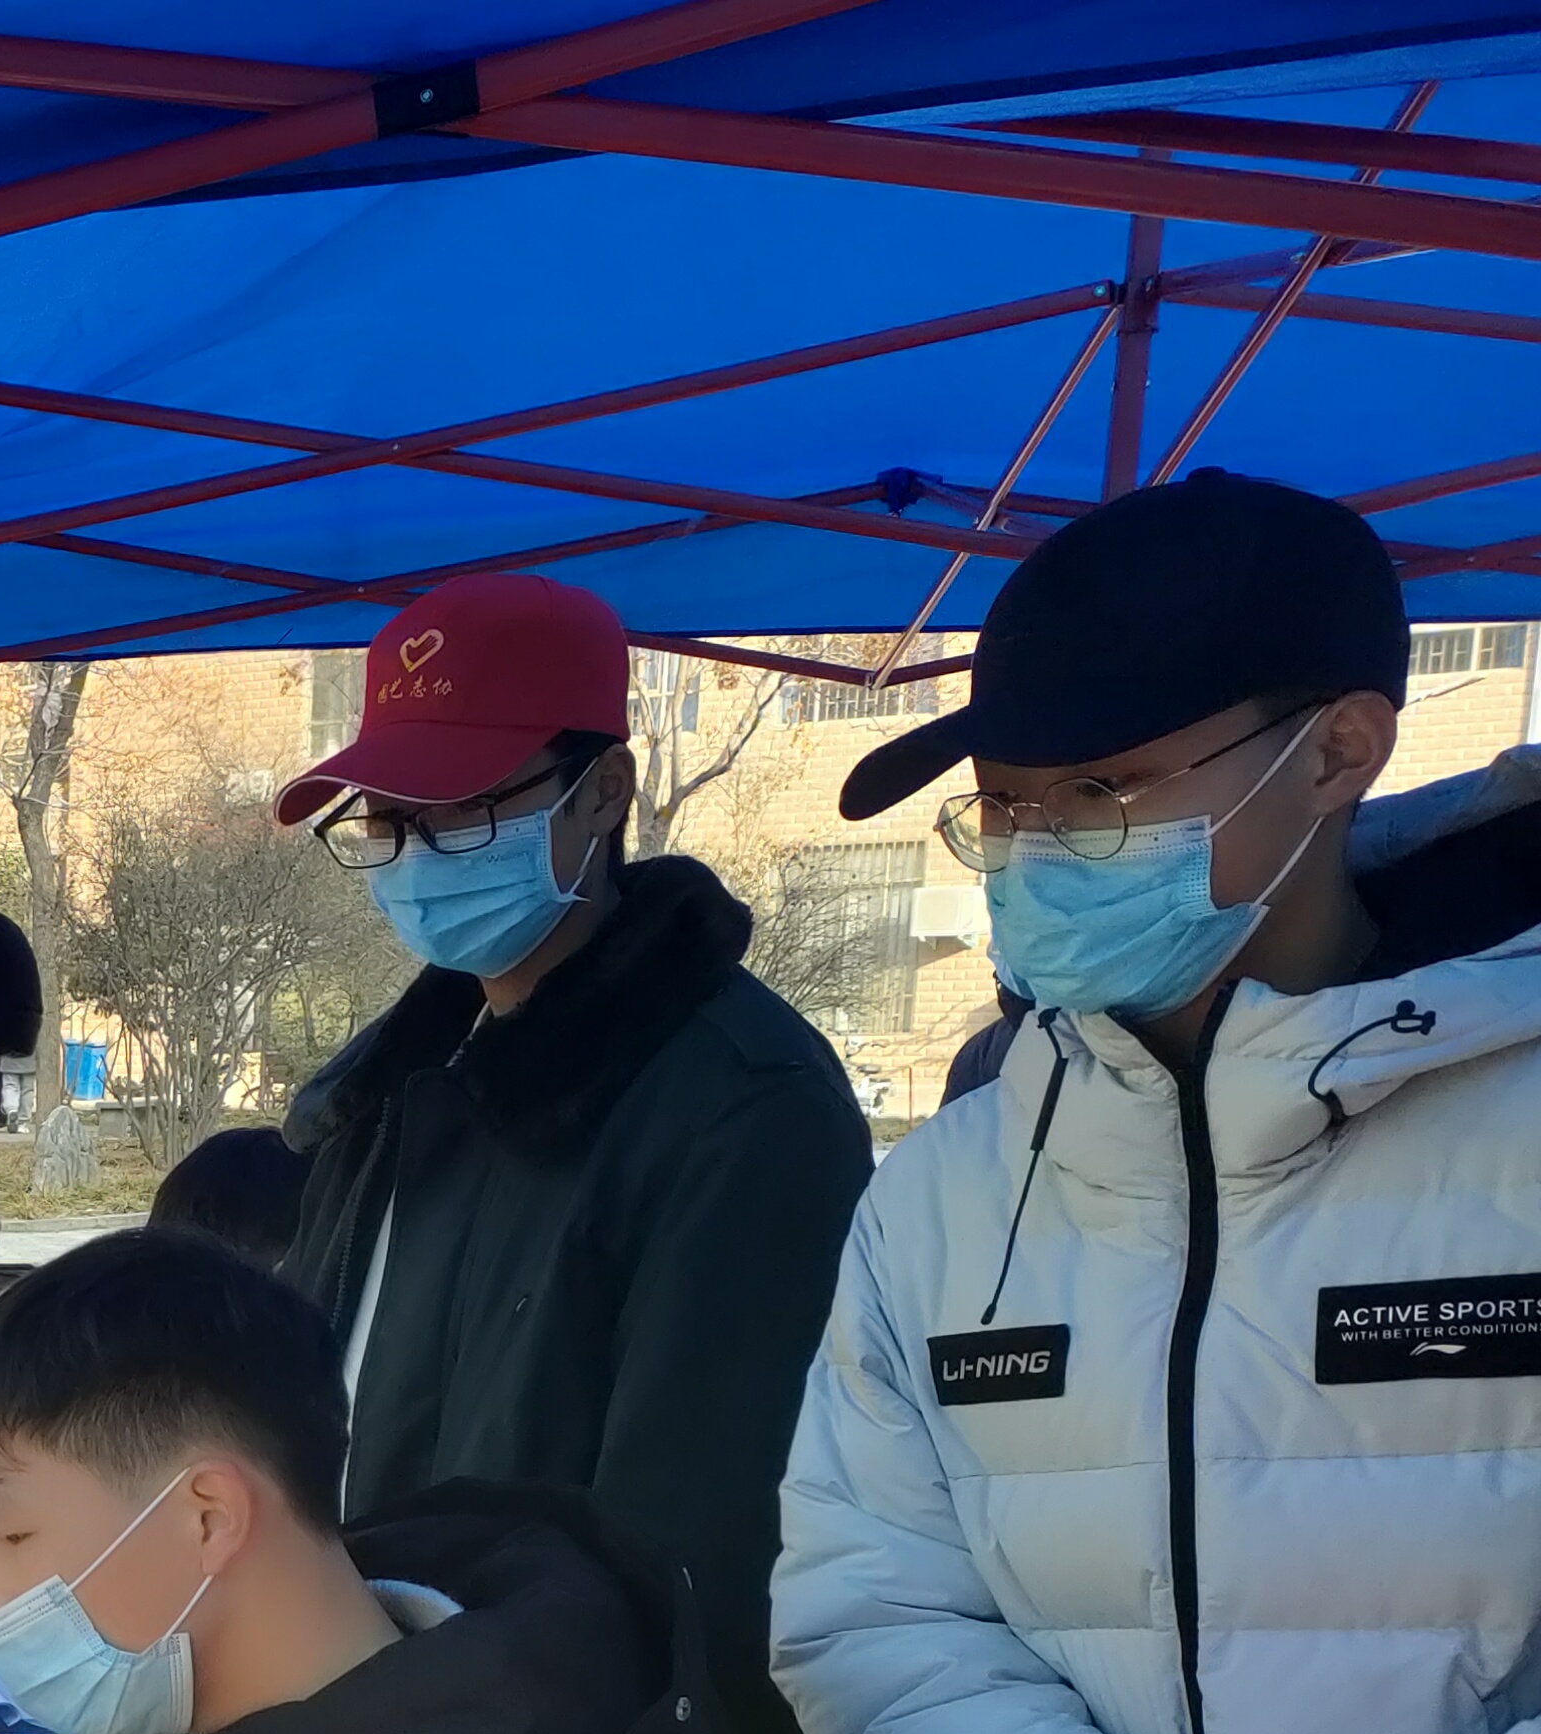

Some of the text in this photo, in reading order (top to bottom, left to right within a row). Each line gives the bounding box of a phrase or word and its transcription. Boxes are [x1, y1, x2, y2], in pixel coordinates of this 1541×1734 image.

[1333, 1303, 1430, 1328] ACTIVE
[1340, 1322, 1541, 1342] WITH BETTER CONDITION
[942, 1350, 1052, 1382] LI-NING
